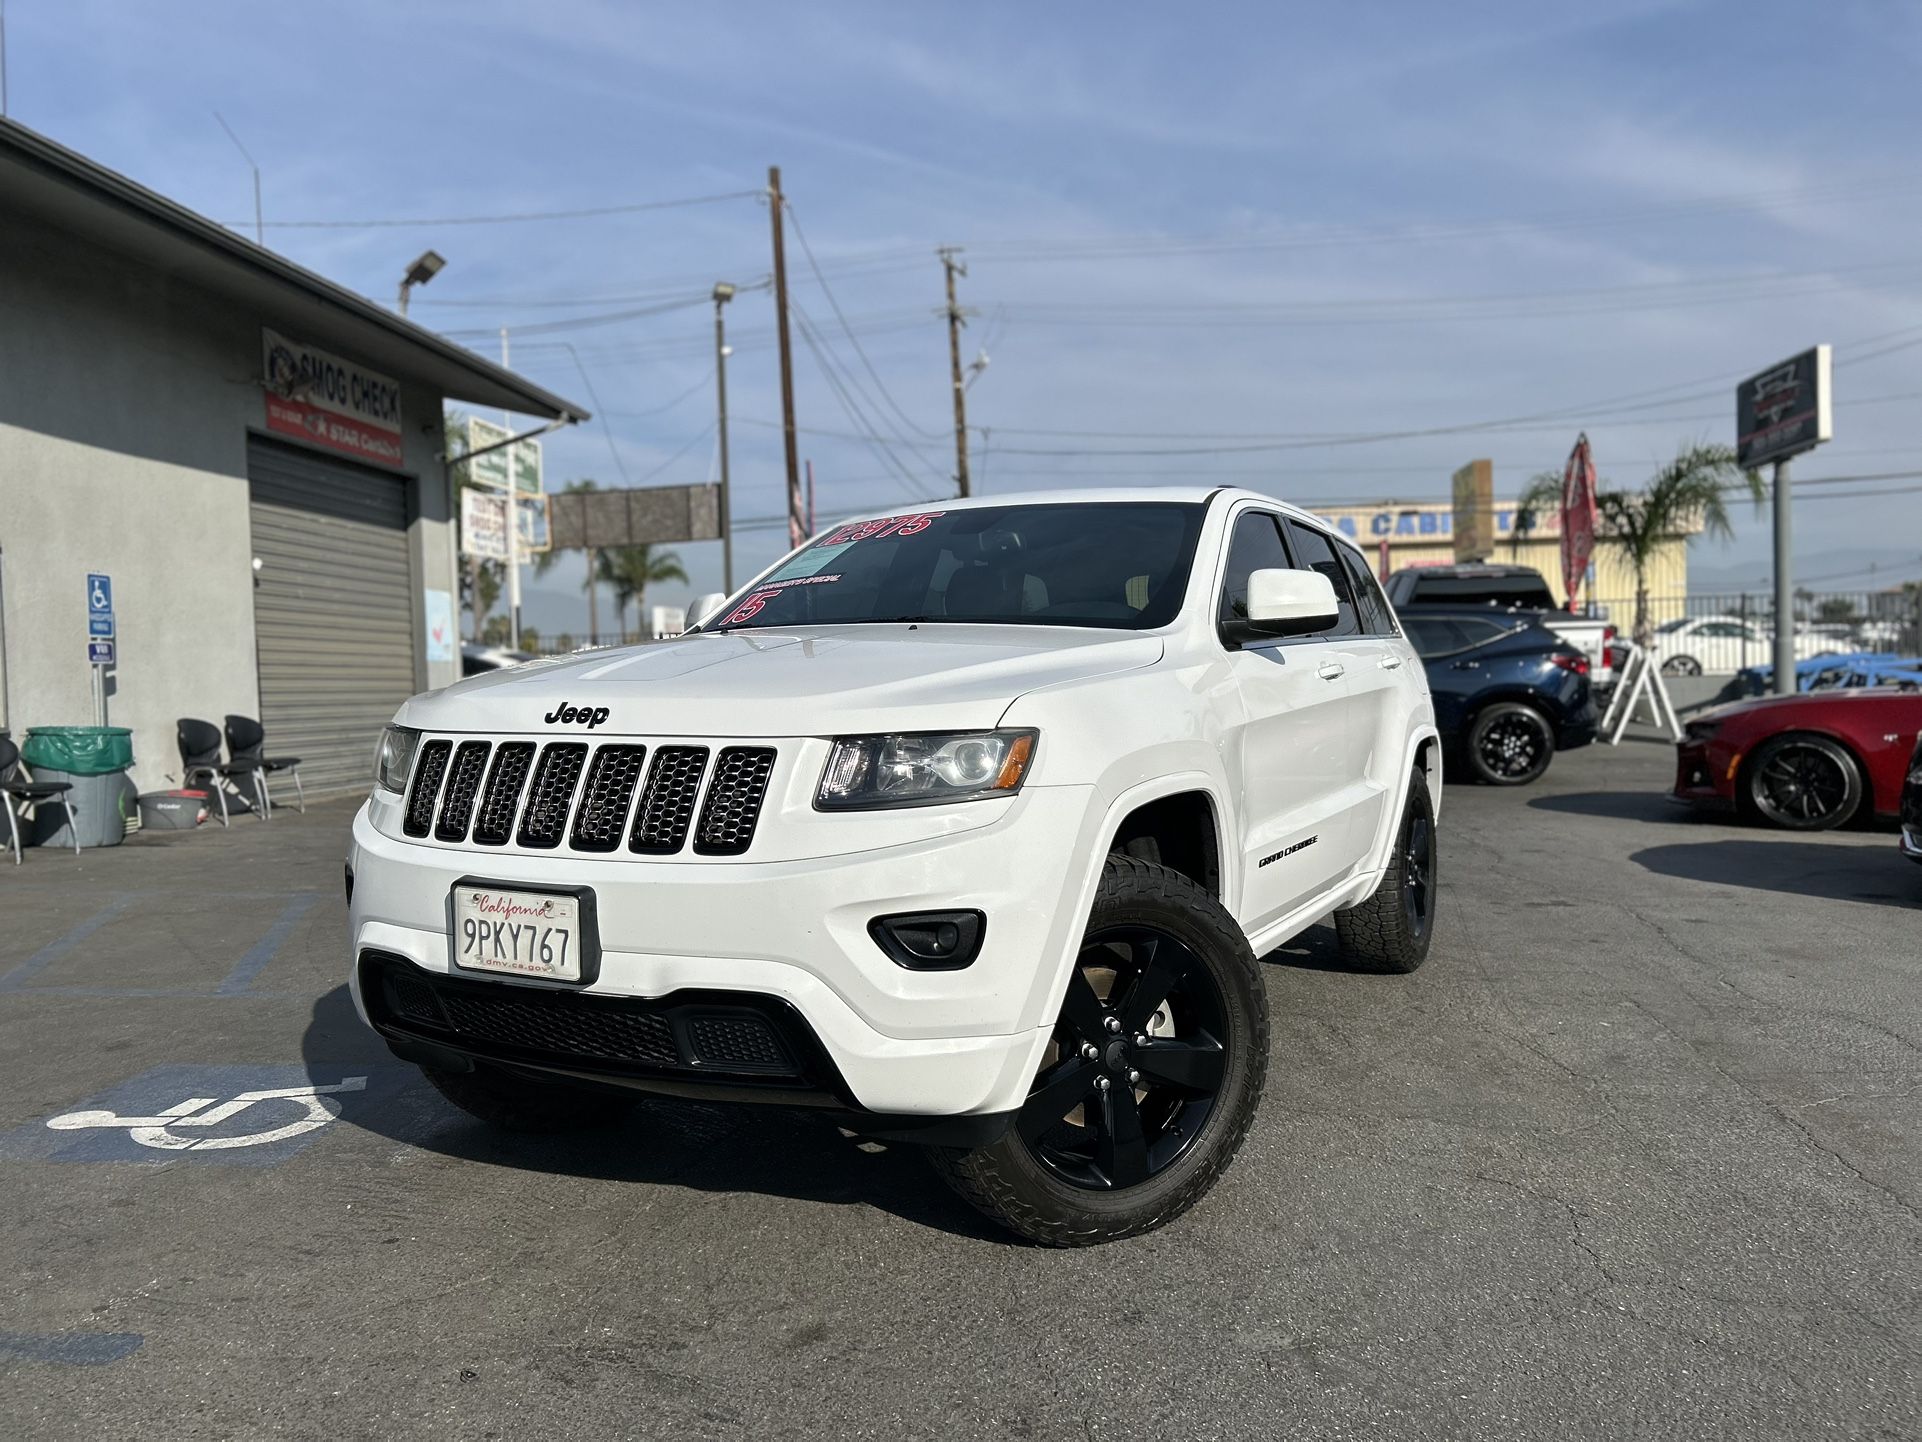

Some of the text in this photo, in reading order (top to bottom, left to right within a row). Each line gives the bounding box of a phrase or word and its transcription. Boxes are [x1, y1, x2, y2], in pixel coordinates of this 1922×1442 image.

[300, 353, 347, 405] SMOG
[351, 372, 399, 423] CHECK
[718, 590, 783, 625] 15
[544, 702, 610, 729] Jeep
[1258, 834, 1319, 868] GRAND CHEROKEE
[480, 895, 552, 920] California
[464, 918, 569, 966] 9PKY767
